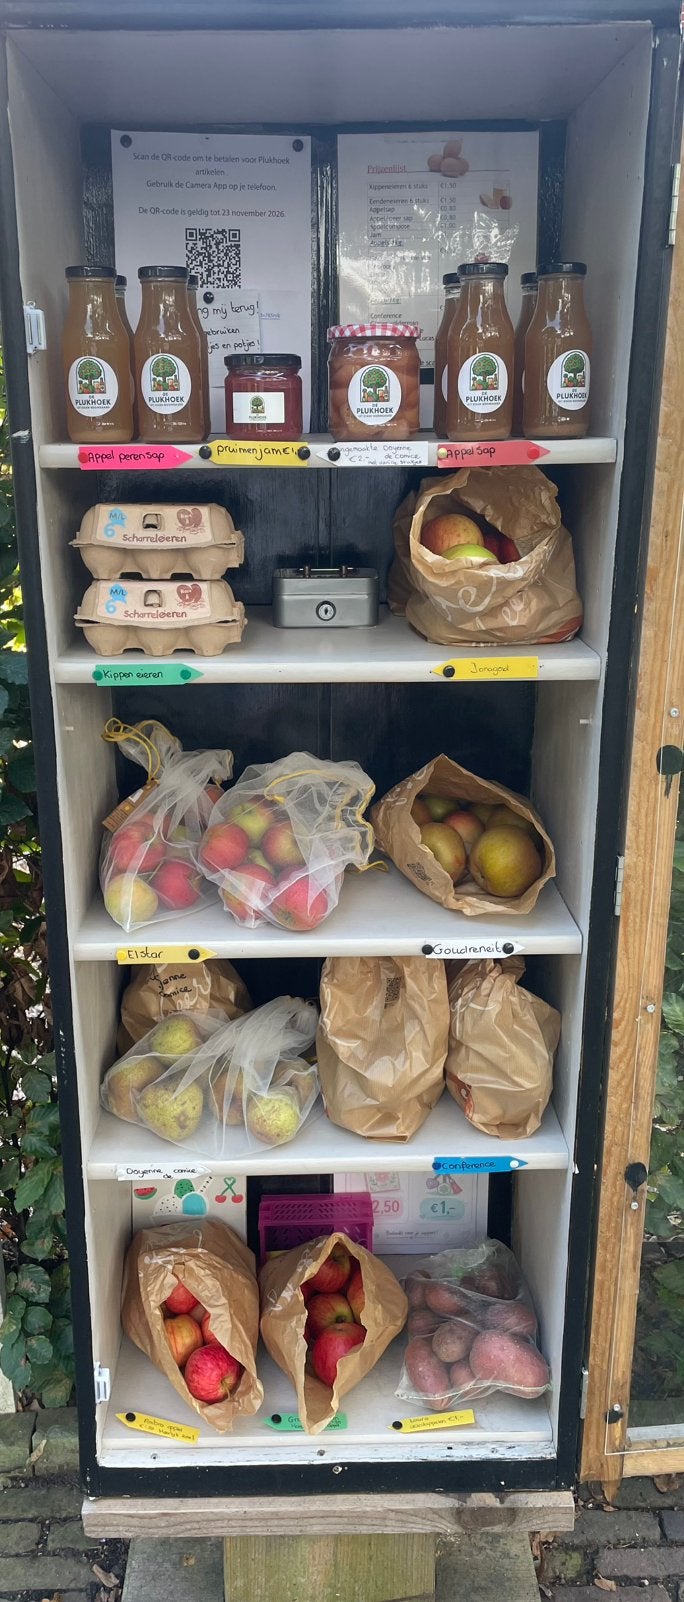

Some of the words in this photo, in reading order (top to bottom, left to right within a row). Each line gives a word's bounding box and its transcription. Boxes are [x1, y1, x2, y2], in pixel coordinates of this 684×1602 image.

[133, 152, 150, 160] Scan
[150, 153, 160, 161] de
[161, 154, 190, 162] QR-code
[214, 154, 240, 163] betalen
[258, 156, 290, 164] Plukhoek
[368, 165, 406, 174] Prijzenlijst
[146, 180, 174, 188] Gebruik
[186, 182, 212, 190] Camera
[213, 183, 228, 192] App
[239, 183, 246, 192] je
[248, 184, 277, 192] telefoon.
[138, 206, 148, 214] De
[150, 207, 179, 216] QR-code
[180, 207, 186, 216] is
[187, 208, 208, 218] geldig
[210, 208, 220, 216] tot
[231, 209, 266, 218] november
[213, 304, 228, 320] mij
[230, 300, 260, 316] terug!
[206, 326, 240, 336] ebruiken
[340, 442, 378, 456] ngemaakte
[446, 448, 474, 460] Appel
[88, 450, 114, 463] Appel
[104, 524, 116, 538] 6
[106, 600, 117, 614] 6
[103, 670, 134, 680] Kippen
[128, 946, 164, 959] Elstar
[441, 1160, 496, 1170] Conference
[126, 1167, 162, 1178] Doyenne
